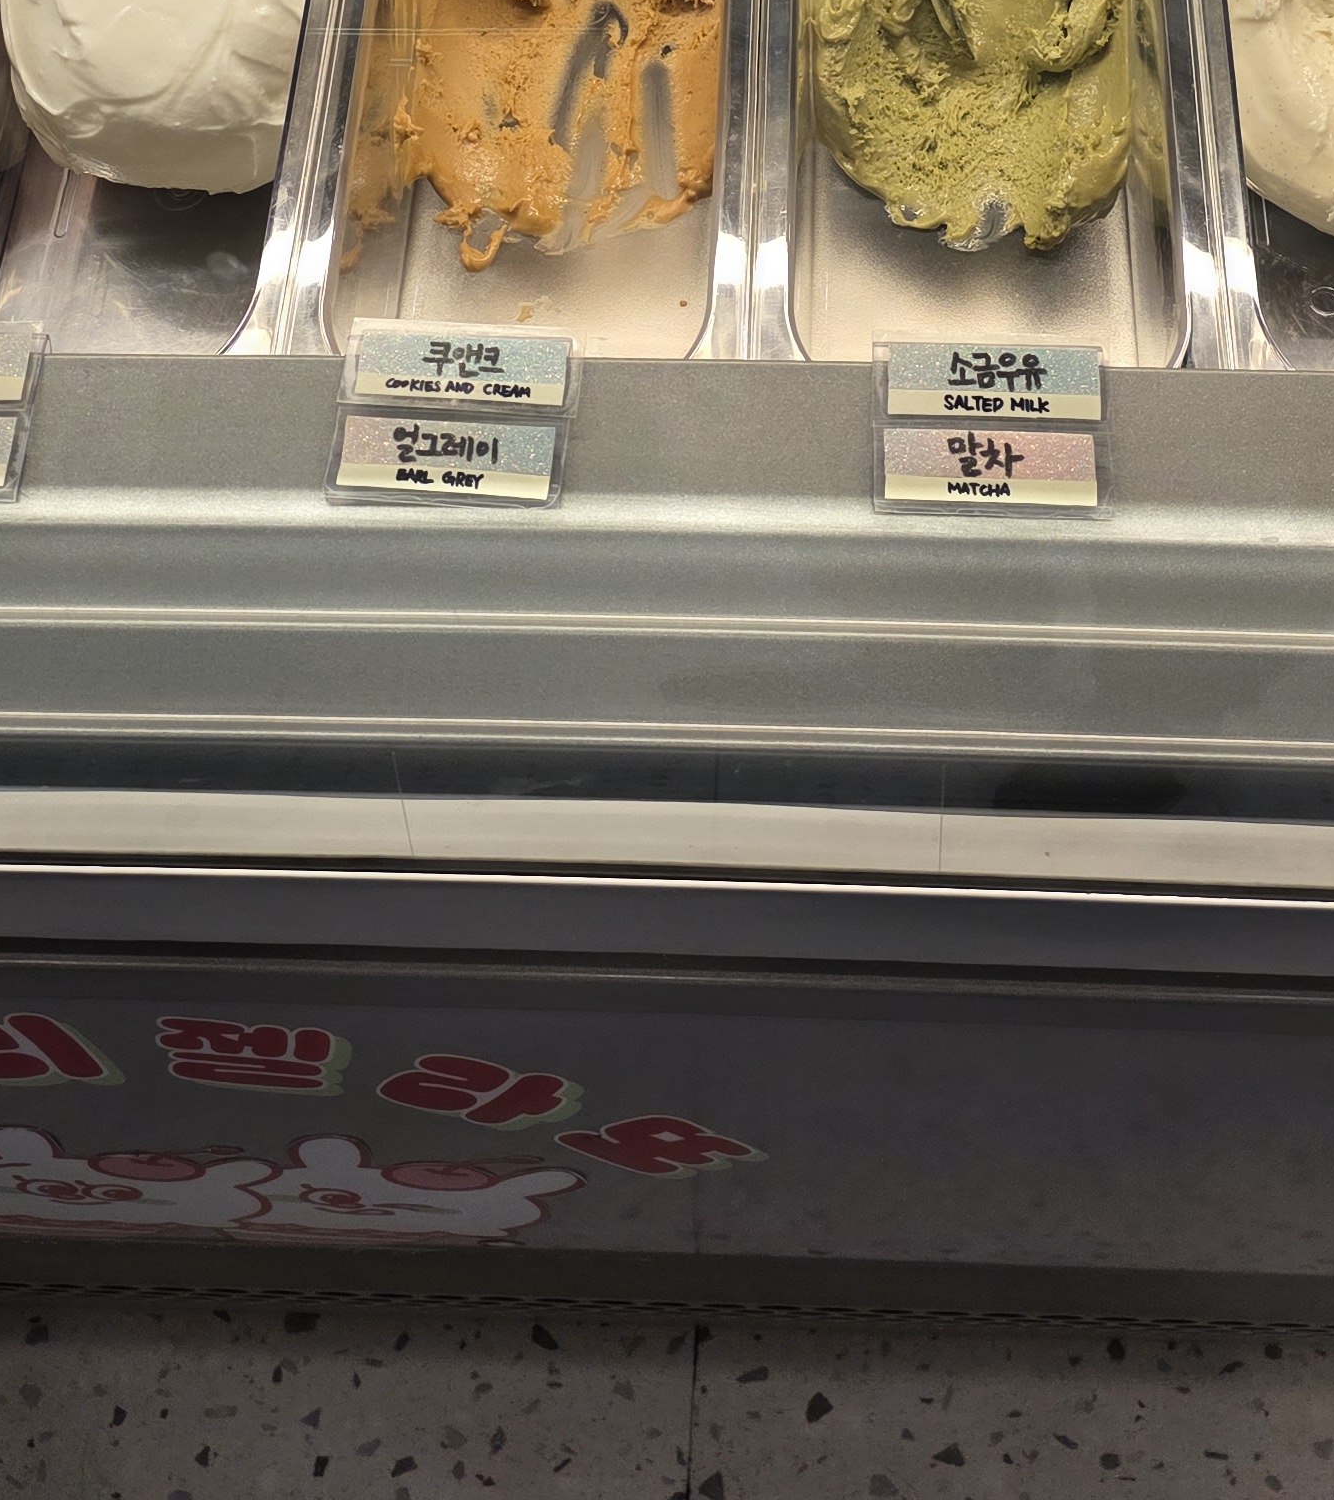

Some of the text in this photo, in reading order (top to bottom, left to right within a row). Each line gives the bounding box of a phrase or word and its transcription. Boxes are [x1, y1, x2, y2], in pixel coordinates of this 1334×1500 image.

[422, 341, 505, 378] 쿠앤크
[947, 351, 1048, 392] 소금우유
[385, 378, 531, 398] COOKIES AND CREAM
[943, 394, 1050, 414] SALTED MILK
[393, 423, 499, 464] 얼그레이
[947, 431, 1024, 479] 말차
[396, 468, 485, 489] EARL GREY
[947, 481, 1011, 497] MATCHA
